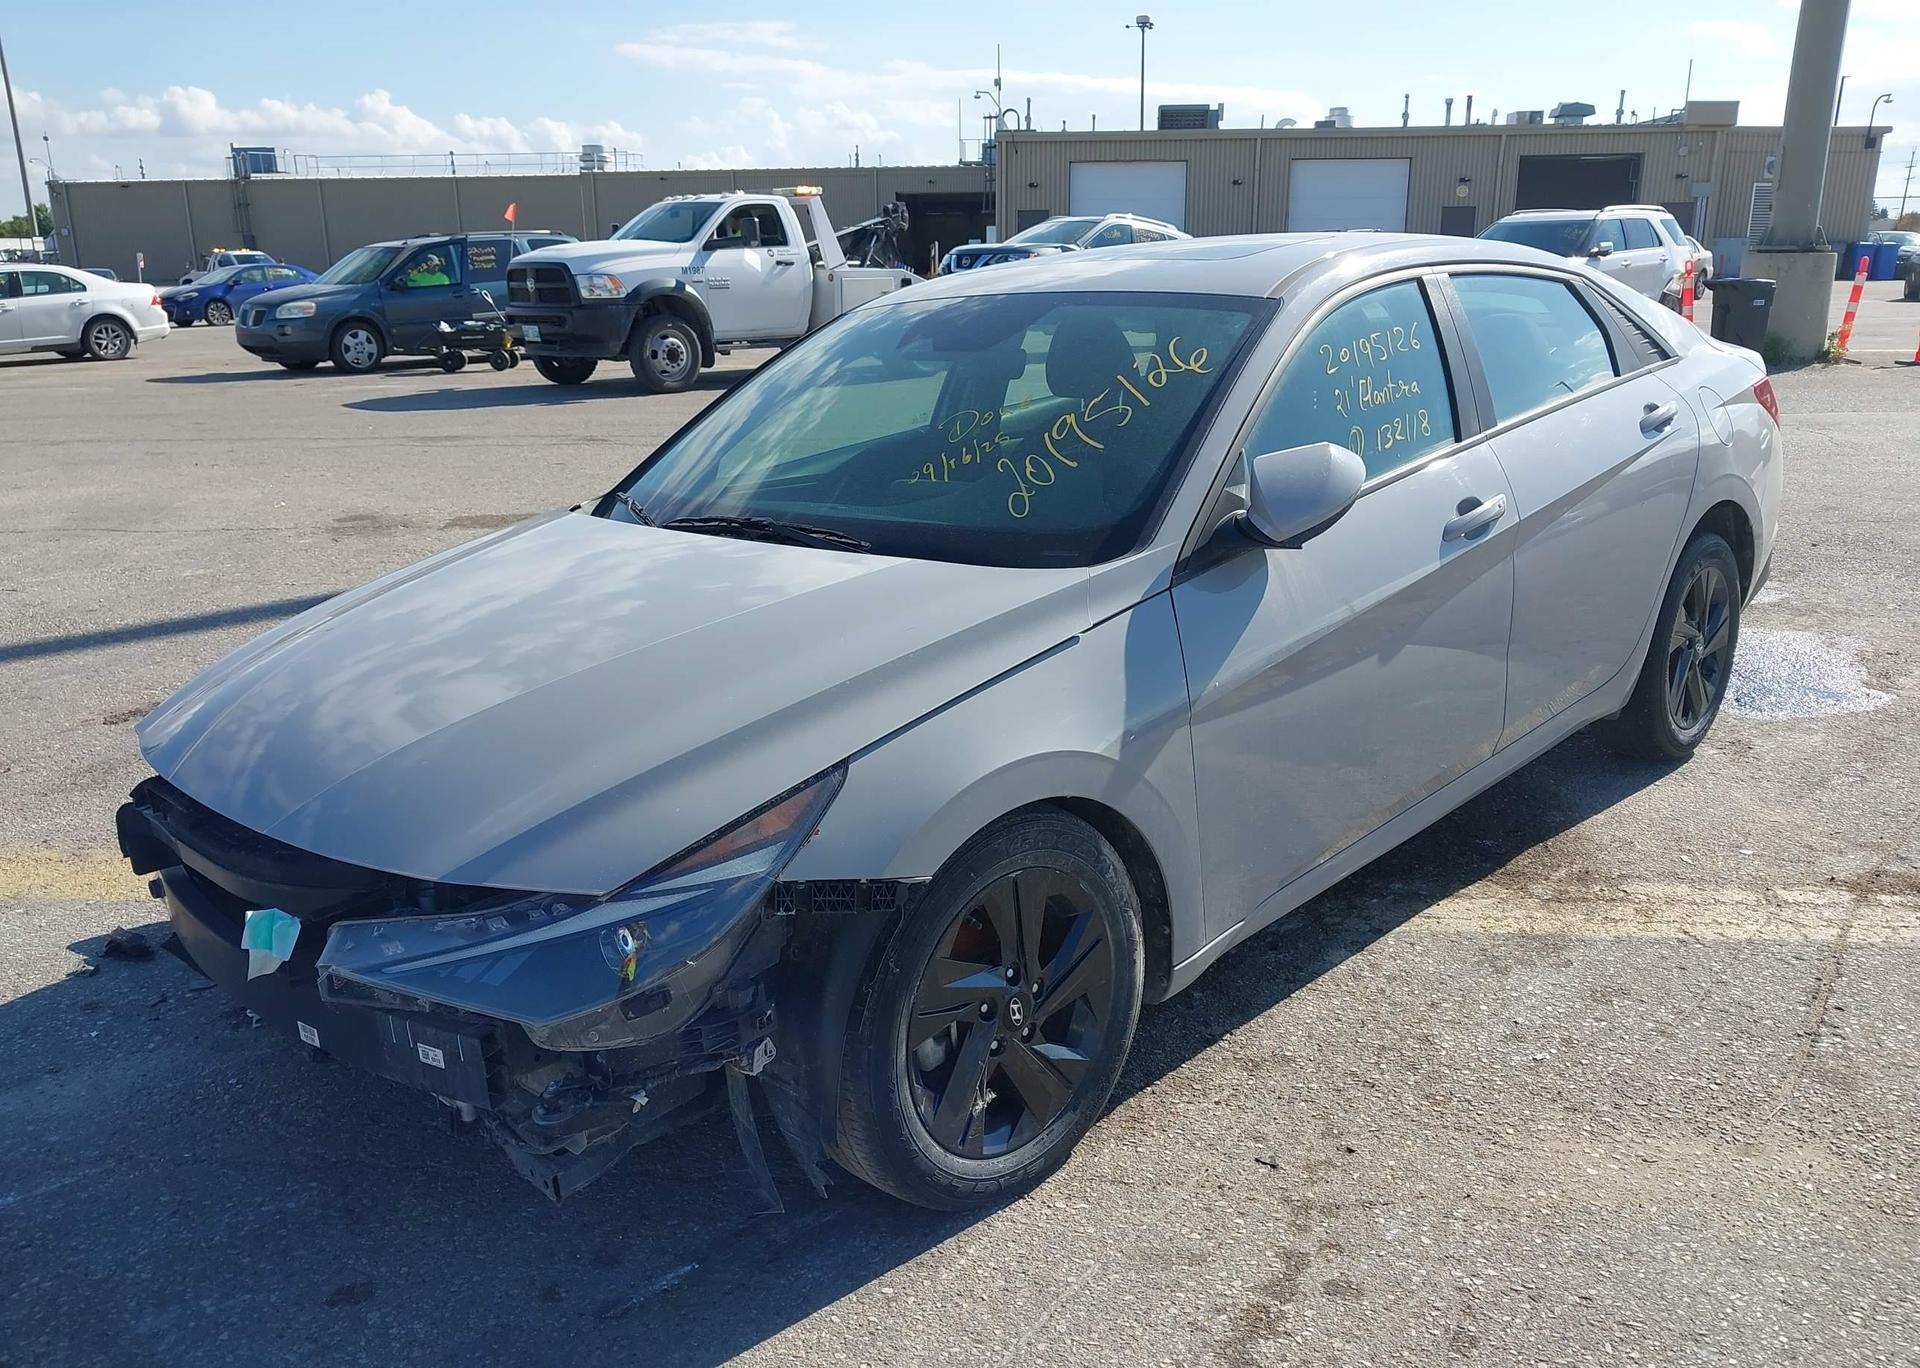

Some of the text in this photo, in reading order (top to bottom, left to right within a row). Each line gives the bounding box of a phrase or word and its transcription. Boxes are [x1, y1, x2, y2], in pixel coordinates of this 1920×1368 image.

[681, 266, 705, 276] M1987
[1319, 322, 1421, 374] 20195126
[997, 336, 1213, 518] 20195126
[1376, 409, 1431, 452] 132118
